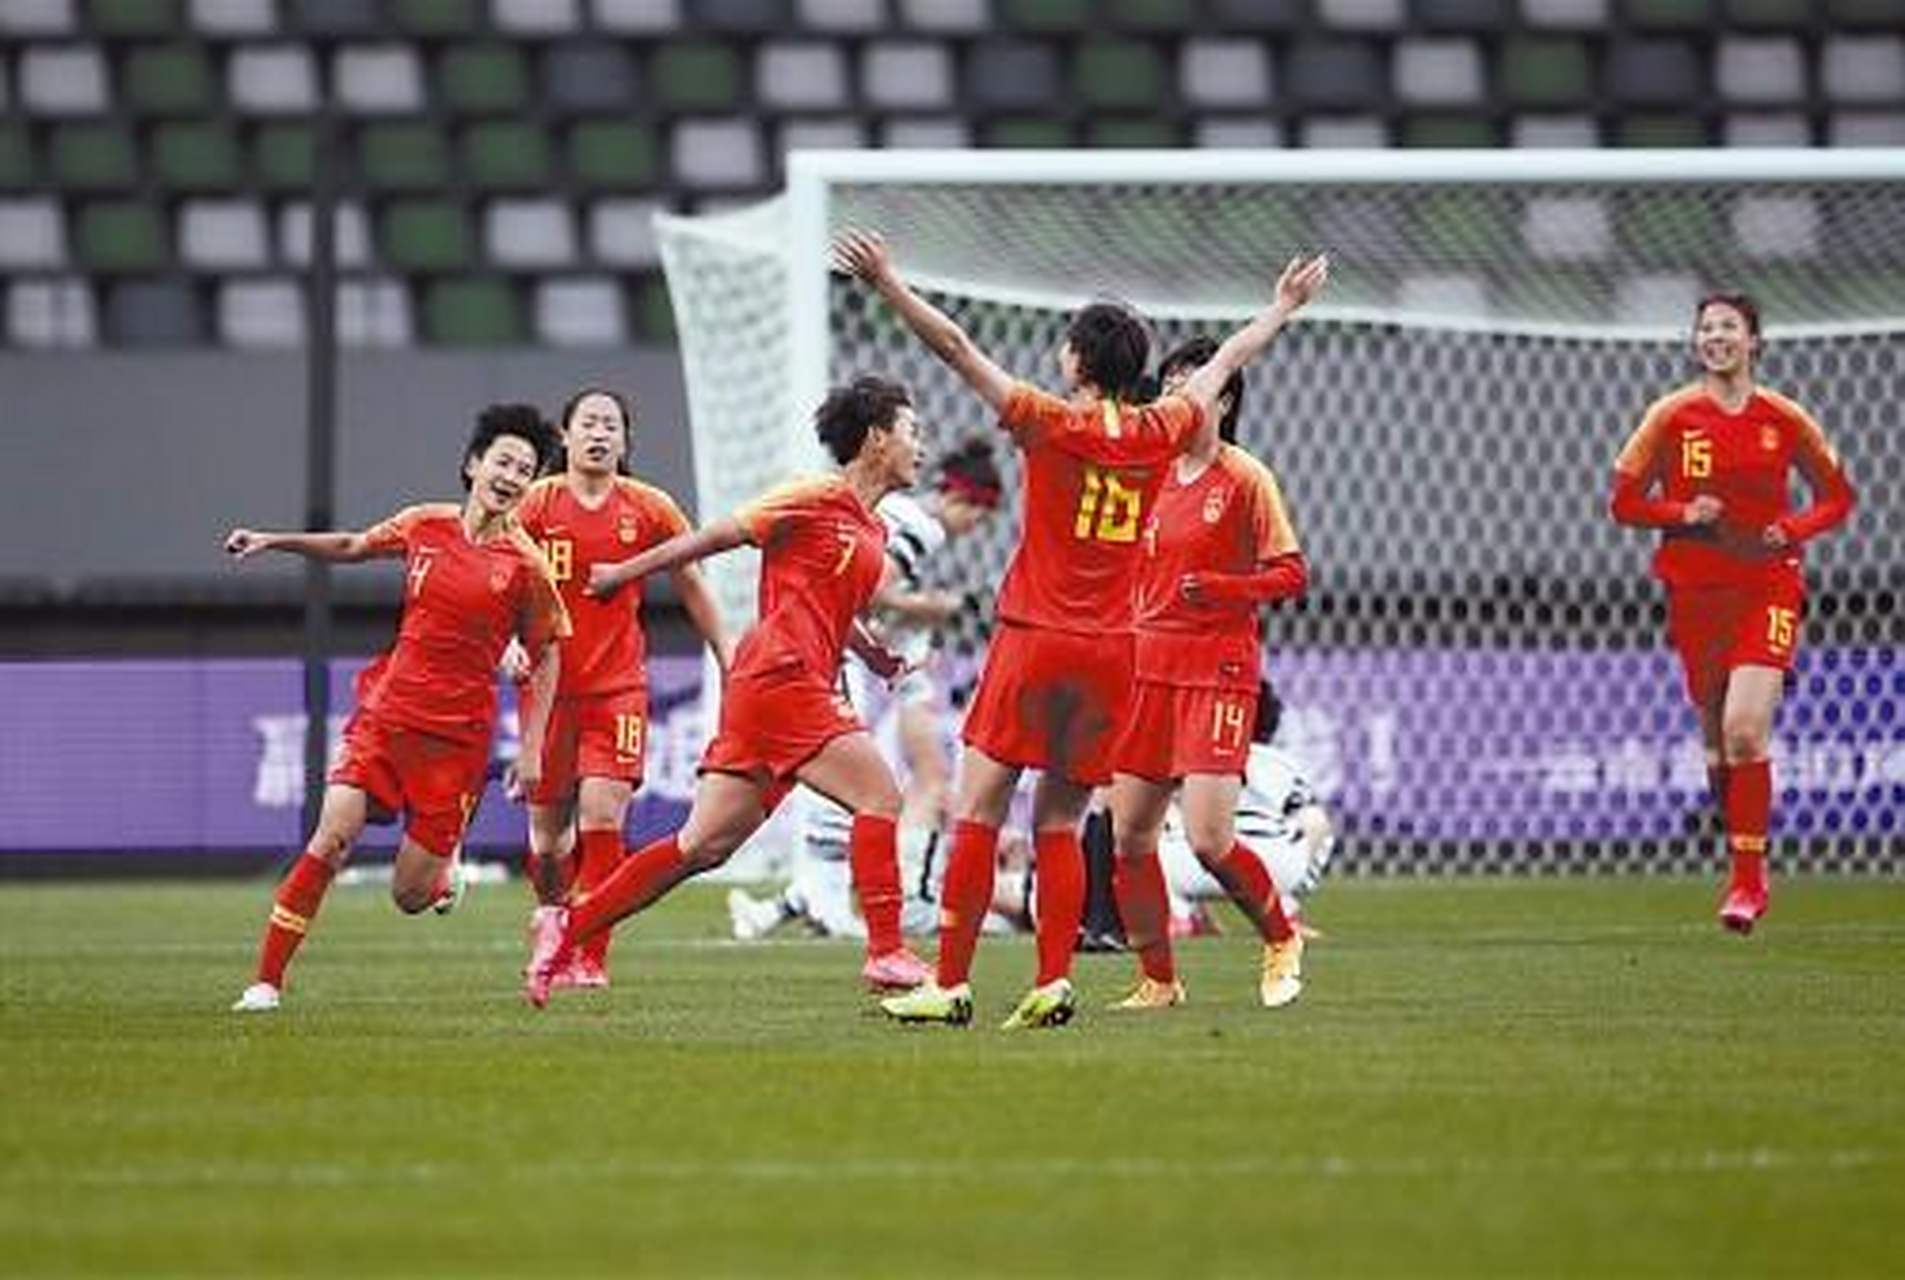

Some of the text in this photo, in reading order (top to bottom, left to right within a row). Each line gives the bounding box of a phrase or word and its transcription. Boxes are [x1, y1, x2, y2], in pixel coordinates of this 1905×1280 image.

[1682, 439, 1712, 478] 15
[836, 533, 856, 575] 7
[408, 554, 432, 597] 4
[1766, 605, 1796, 644] 15
[616, 713, 642, 755] 18
[1212, 700, 1244, 748] 14
